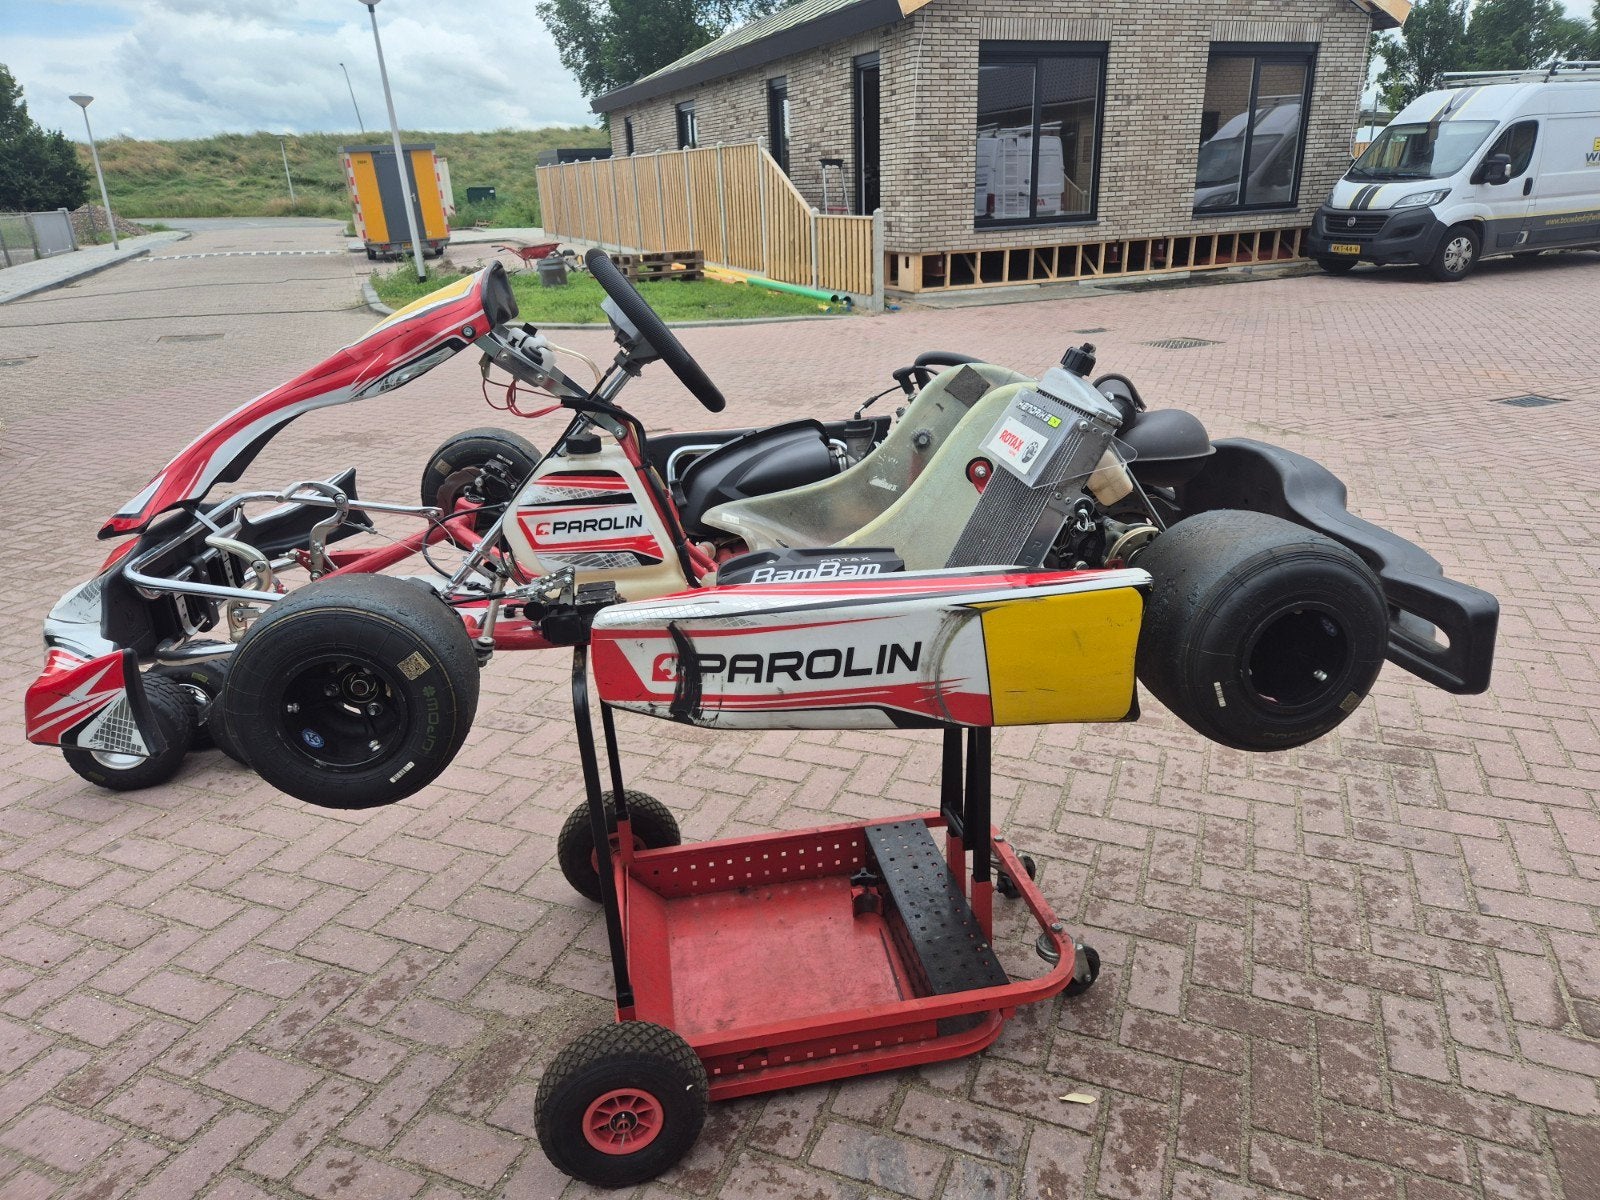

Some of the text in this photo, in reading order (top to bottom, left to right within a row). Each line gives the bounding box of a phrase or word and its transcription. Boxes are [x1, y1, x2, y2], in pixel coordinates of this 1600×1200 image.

[999, 429, 1025, 452] ROTAX
[552, 514, 643, 535] PAROLIN
[695, 641, 923, 684] PAROLIN
